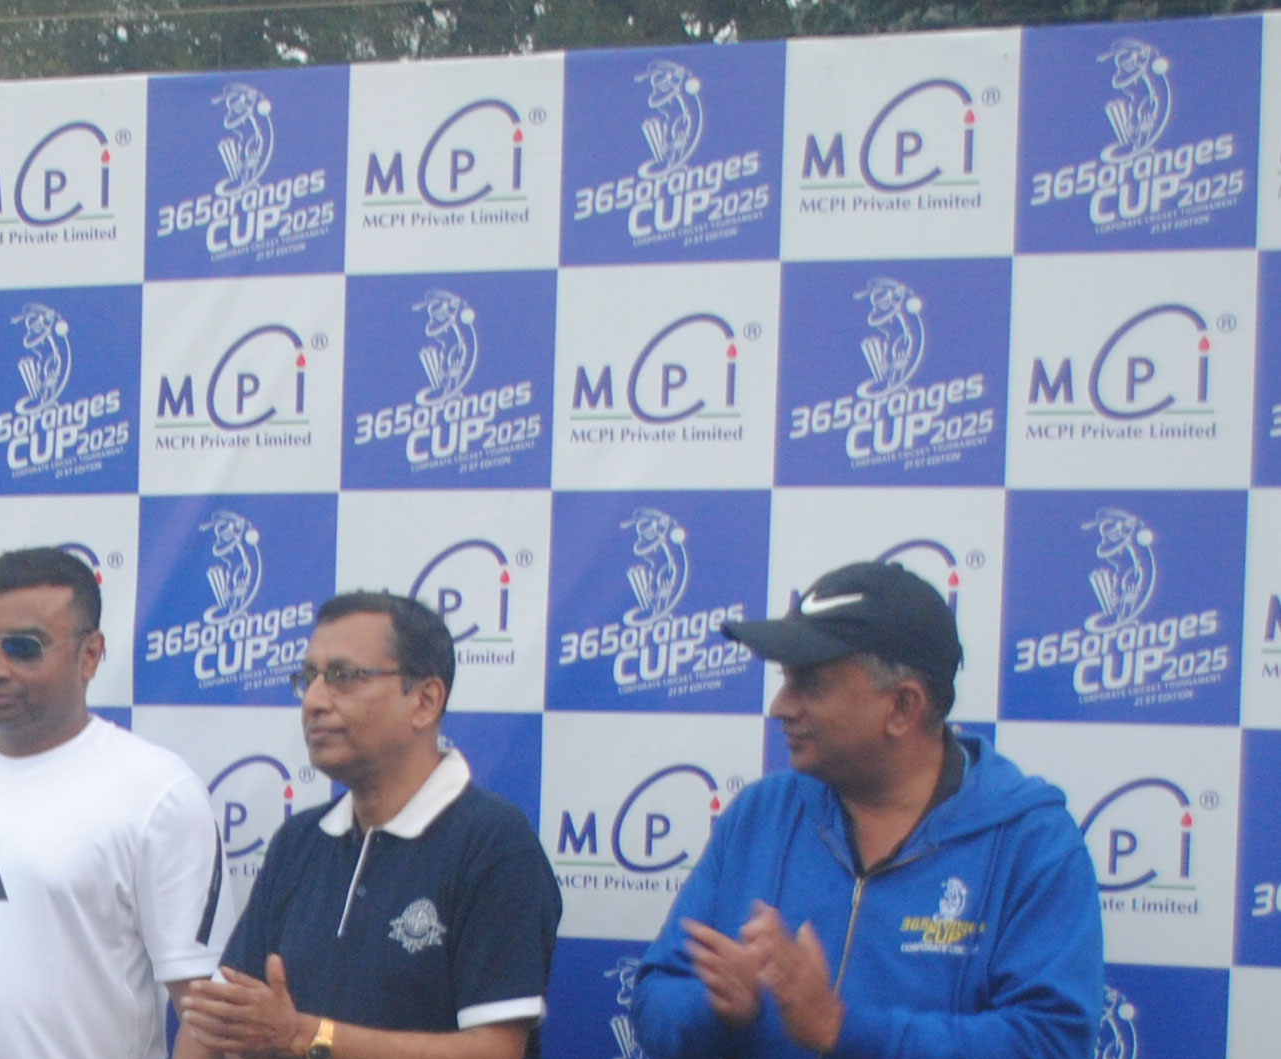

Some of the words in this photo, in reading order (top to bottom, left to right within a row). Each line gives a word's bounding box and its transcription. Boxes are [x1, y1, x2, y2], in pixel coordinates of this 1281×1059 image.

[1030, 133, 1233, 206] 365oranges
[573, 150, 759, 220] 365oranges
[156, 168, 325, 237] 365oranges
[799, 197, 845, 214] MCPI
[852, 194, 910, 212] Private
[917, 192, 981, 210] Limited
[362, 213, 404, 229] MCPI
[410, 210, 464, 227] Private
[470, 207, 528, 225] Limited
[8, 228, 57, 245] Private
[63, 225, 116, 242] Limited
[354, 380, 531, 445] 365oranges
[788, 373, 984, 439] 365oranges
[155, 435, 194, 450] MCPI
[200, 432, 250, 449] Private
[256, 430, 310, 447] Limited
[570, 428, 613, 444] MCPI
[620, 426, 675, 442] Private
[681, 424, 742, 441] Limited
[1026, 424, 1074, 440] MCPI
[1081, 423, 1142, 439] Private
[1149, 422, 1216, 439] Limited
[145, 601, 312, 661] 365oranges
[1013, 609, 1218, 672] 365oranges
[457, 648, 515, 664] Limited
[604, 874, 659, 890] Private
[1132, 895, 1198, 914] Limited
